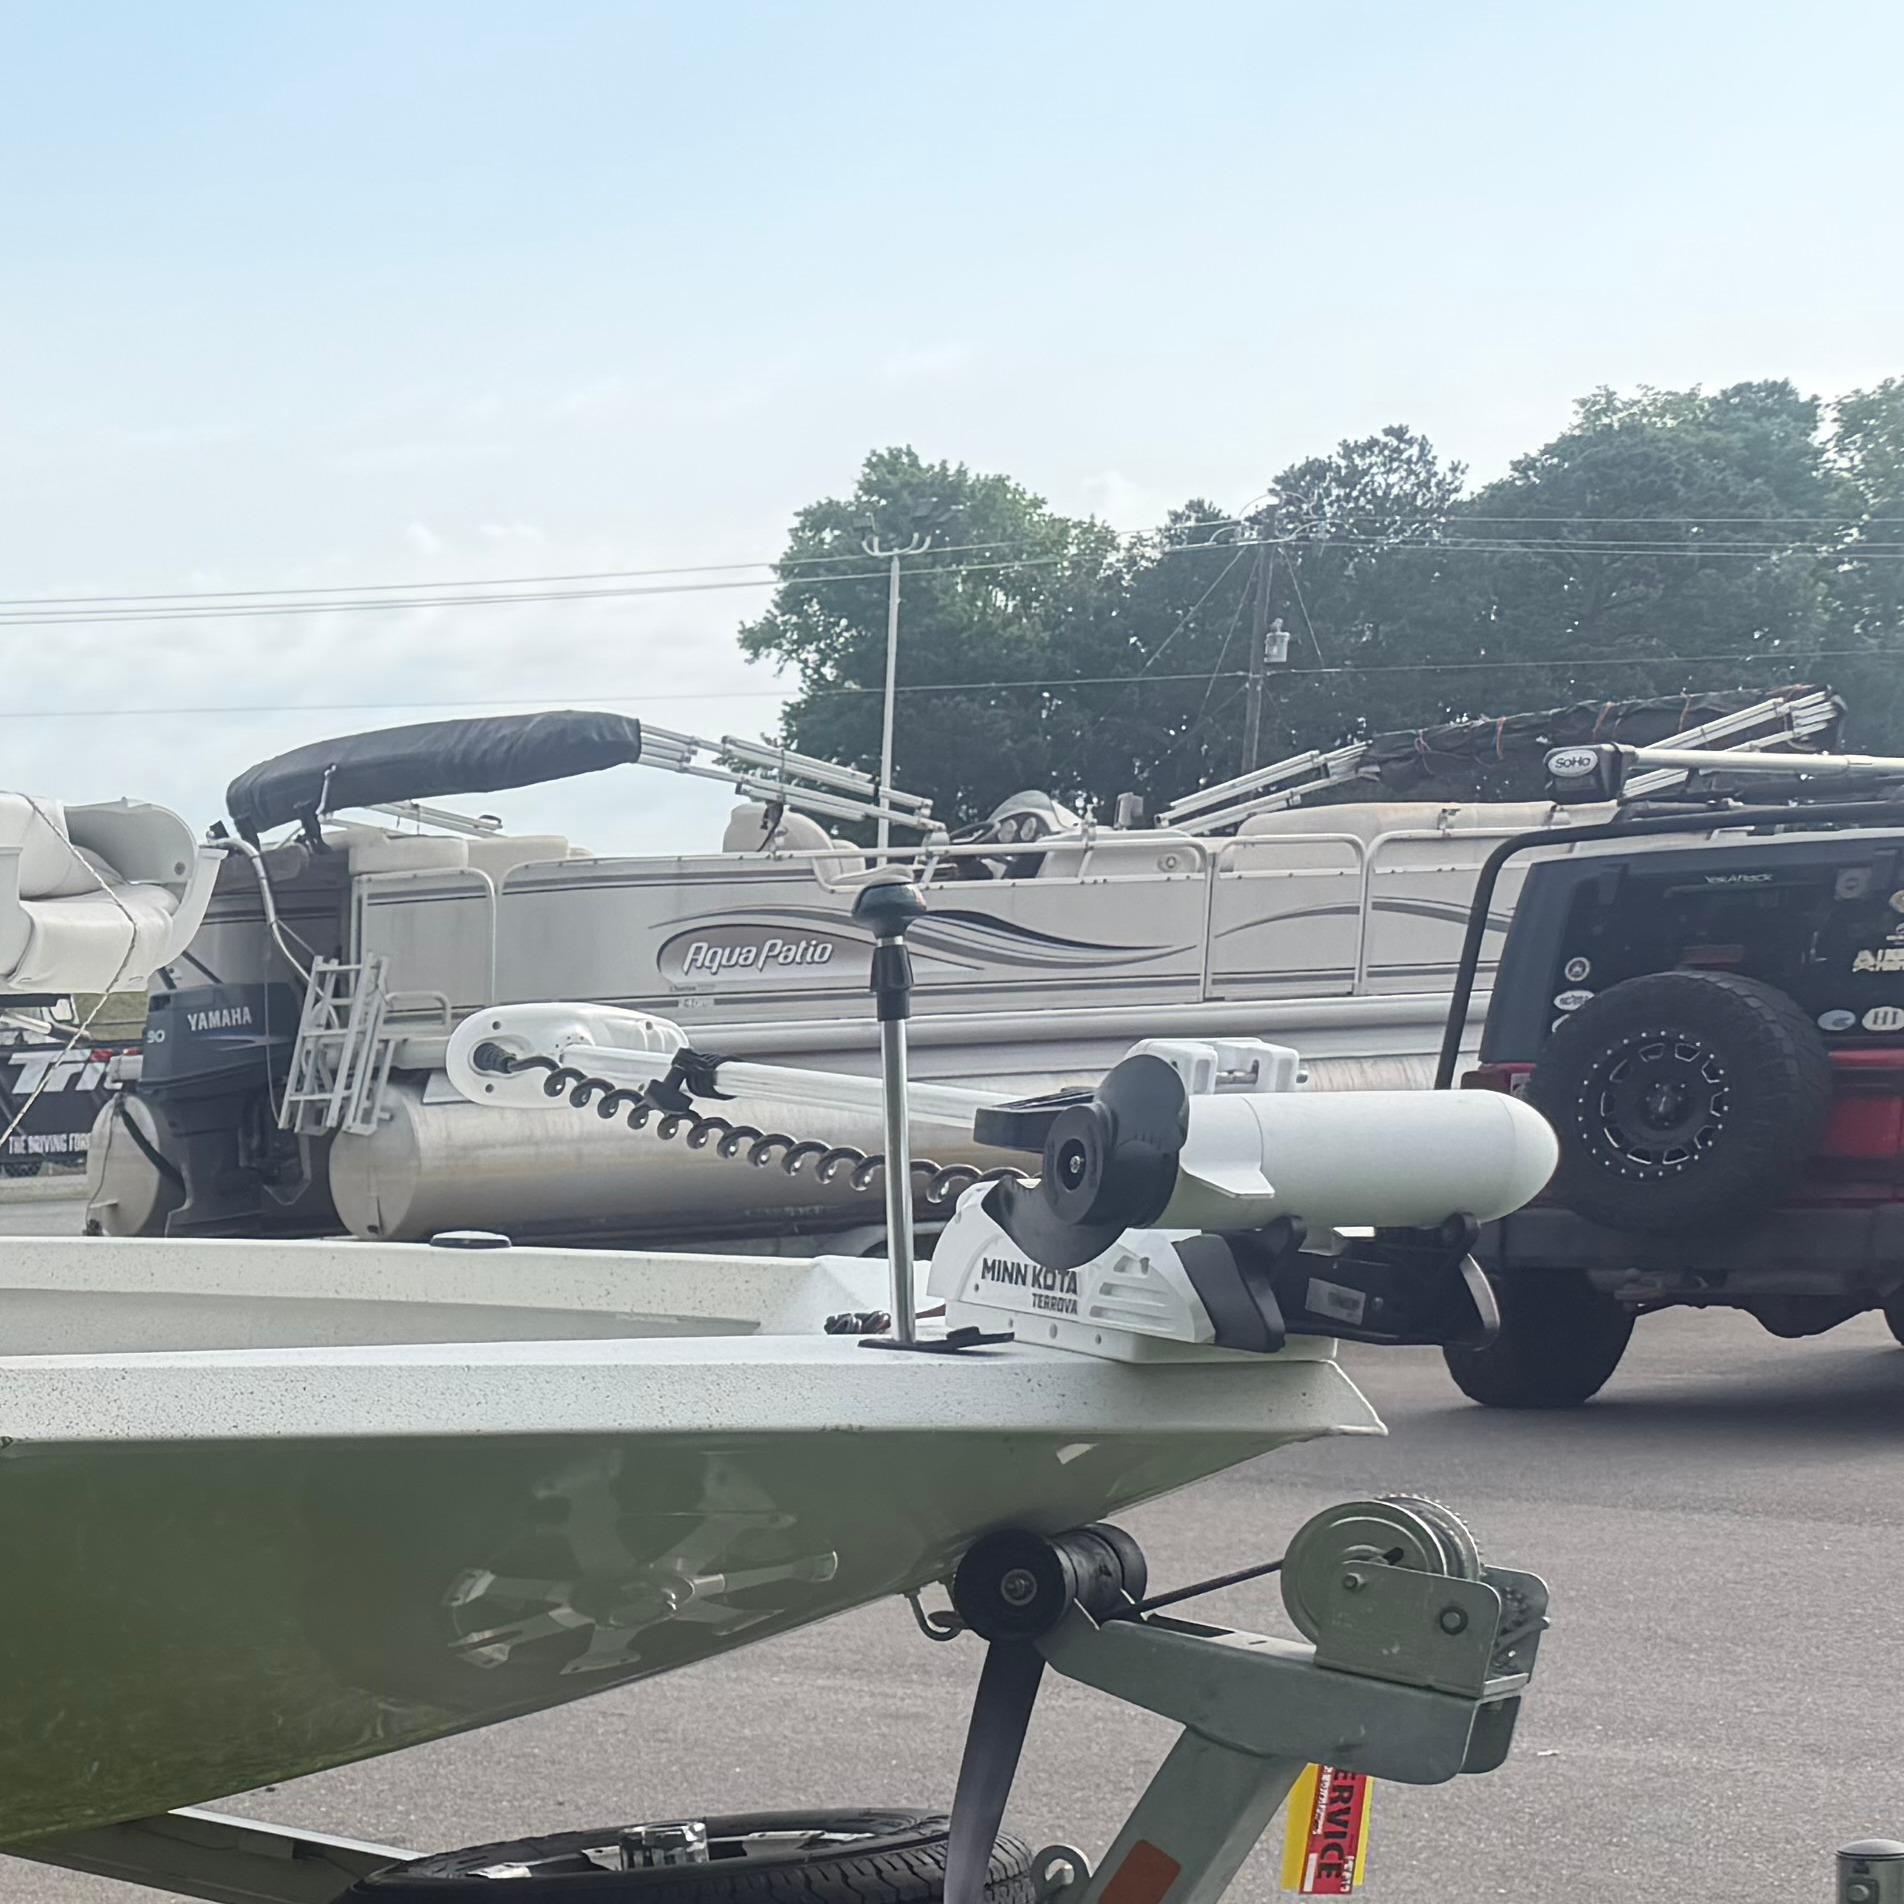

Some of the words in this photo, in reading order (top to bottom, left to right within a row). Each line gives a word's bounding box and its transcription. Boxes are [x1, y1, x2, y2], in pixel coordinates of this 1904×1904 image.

[187, 1007, 252, 1031] YAMAHA
[147, 1030, 165, 1043] 90
[9, 1136, 26, 1154] THE
[28, 1134, 67, 1154] DRIVING
[981, 1258, 1028, 1286] MINN
[1031, 1265, 1078, 1295] KOTA
[1032, 1293, 1078, 1315] TERROVA
[1317, 1769, 1354, 1879] ERVICE
